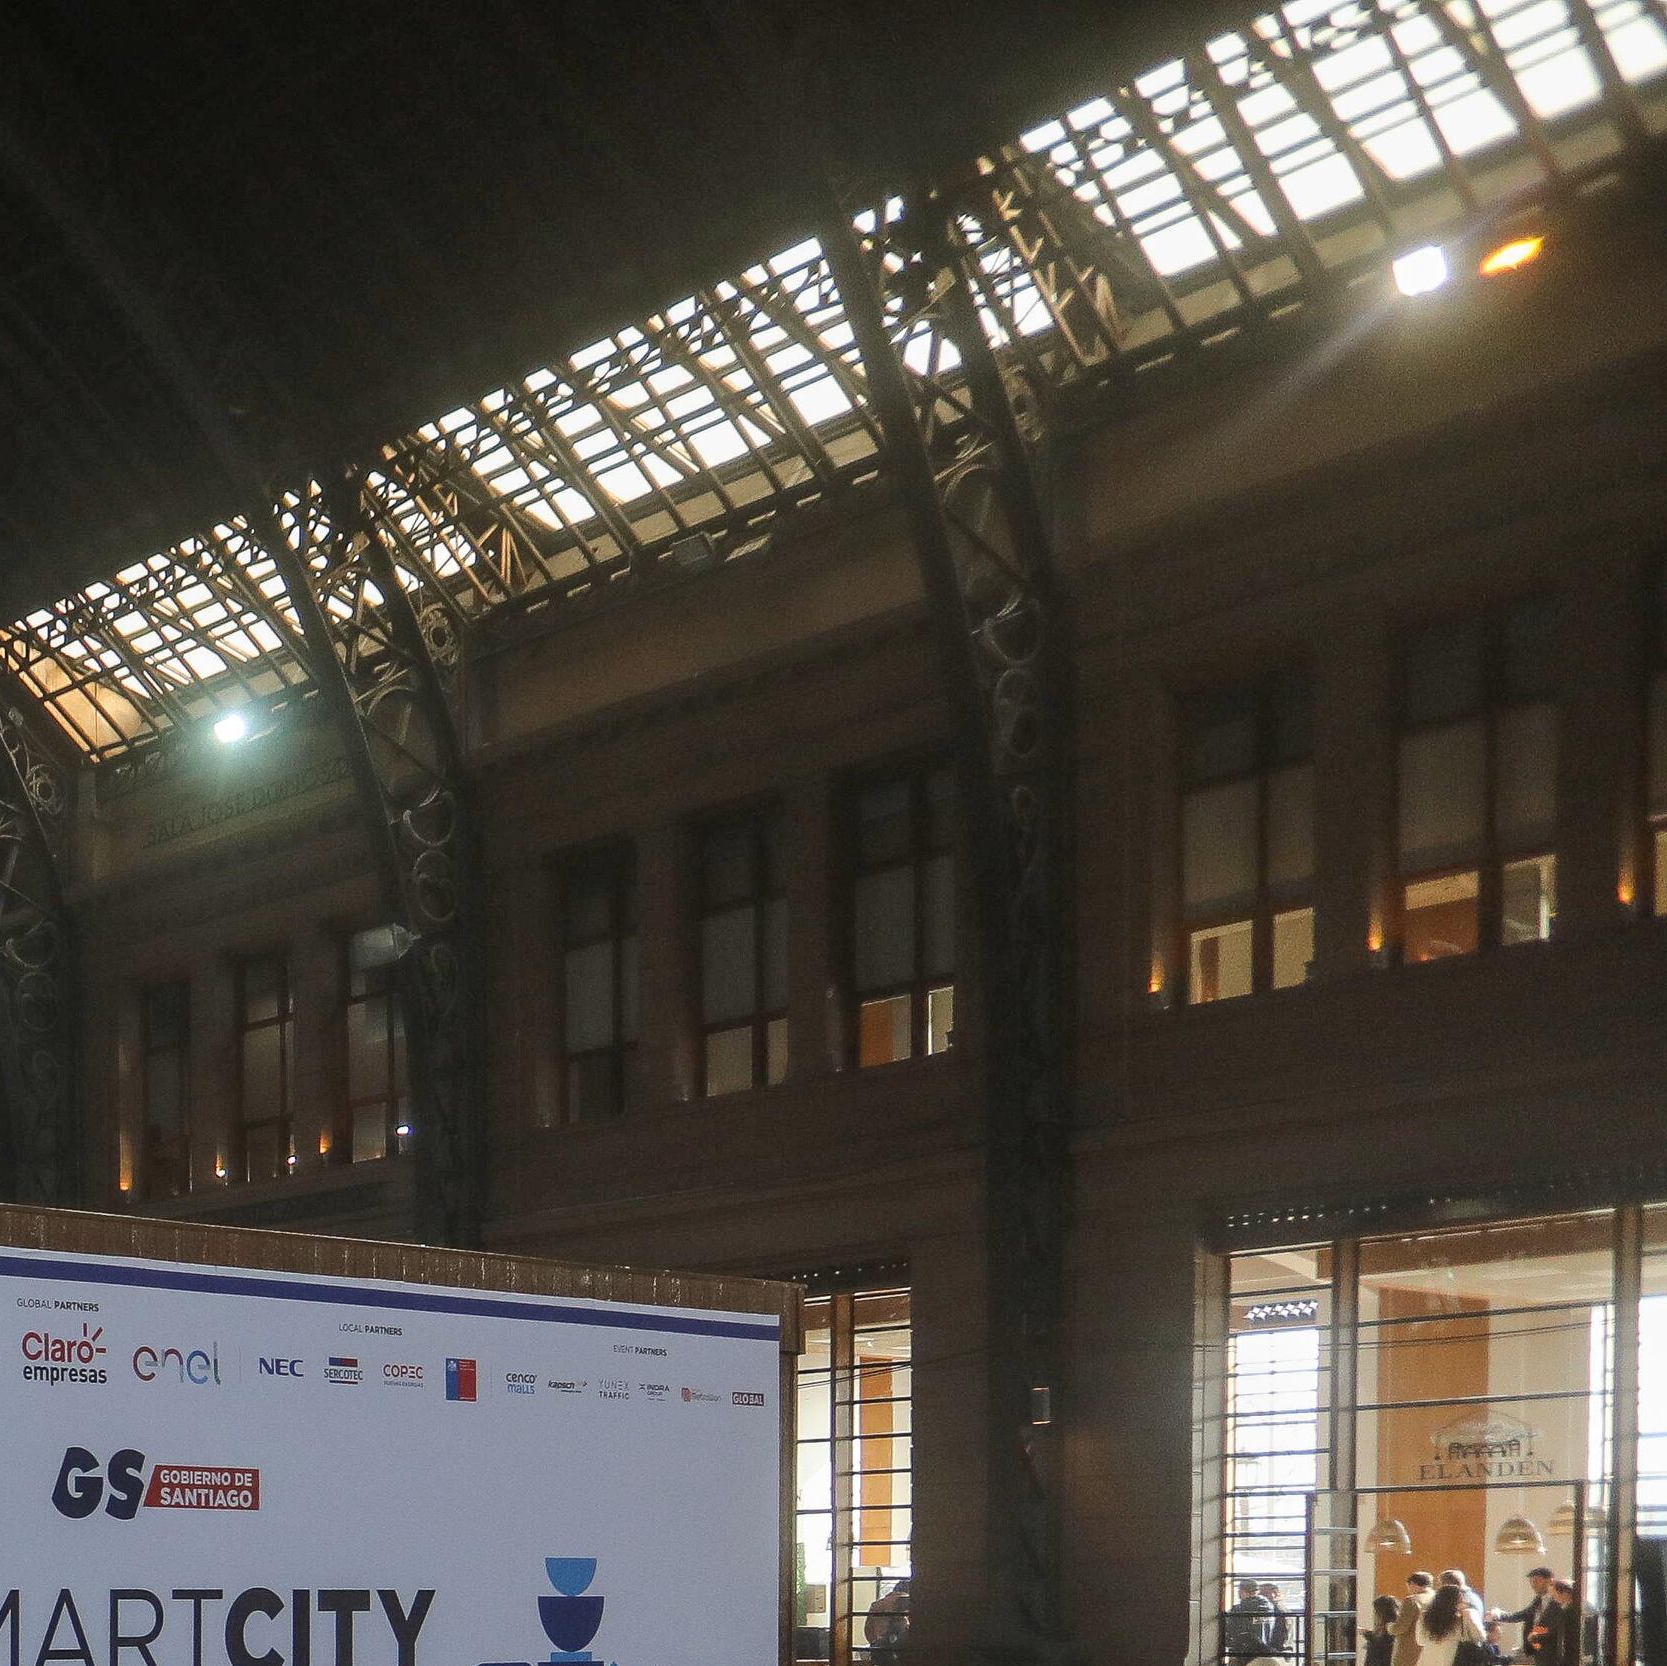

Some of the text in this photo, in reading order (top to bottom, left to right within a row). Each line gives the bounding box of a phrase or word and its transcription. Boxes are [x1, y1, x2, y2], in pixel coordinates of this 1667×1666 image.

[17, 1297, 100, 1313] GLOBAL PARTNERS
[338, 1323, 403, 1337] LOCAL PARTNERS
[21, 1331, 96, 1364] Claro
[634, 1346, 668, 1357] PARTNERS
[132, 1341, 221, 1386] enel
[258, 1357, 305, 1378] NEC
[382, 1363, 424, 1380] COPEC
[22, 1364, 108, 1386] empresas
[323, 1367, 364, 1381] SERCOTEC
[505, 1372, 535, 1384] cenco
[598, 1390, 630, 1400] TRAFFIC
[51, 1446, 146, 1520] GS
[160, 1468, 253, 1487] GOBIERNO DE
[160, 1487, 252, 1508] SANTIAGO
